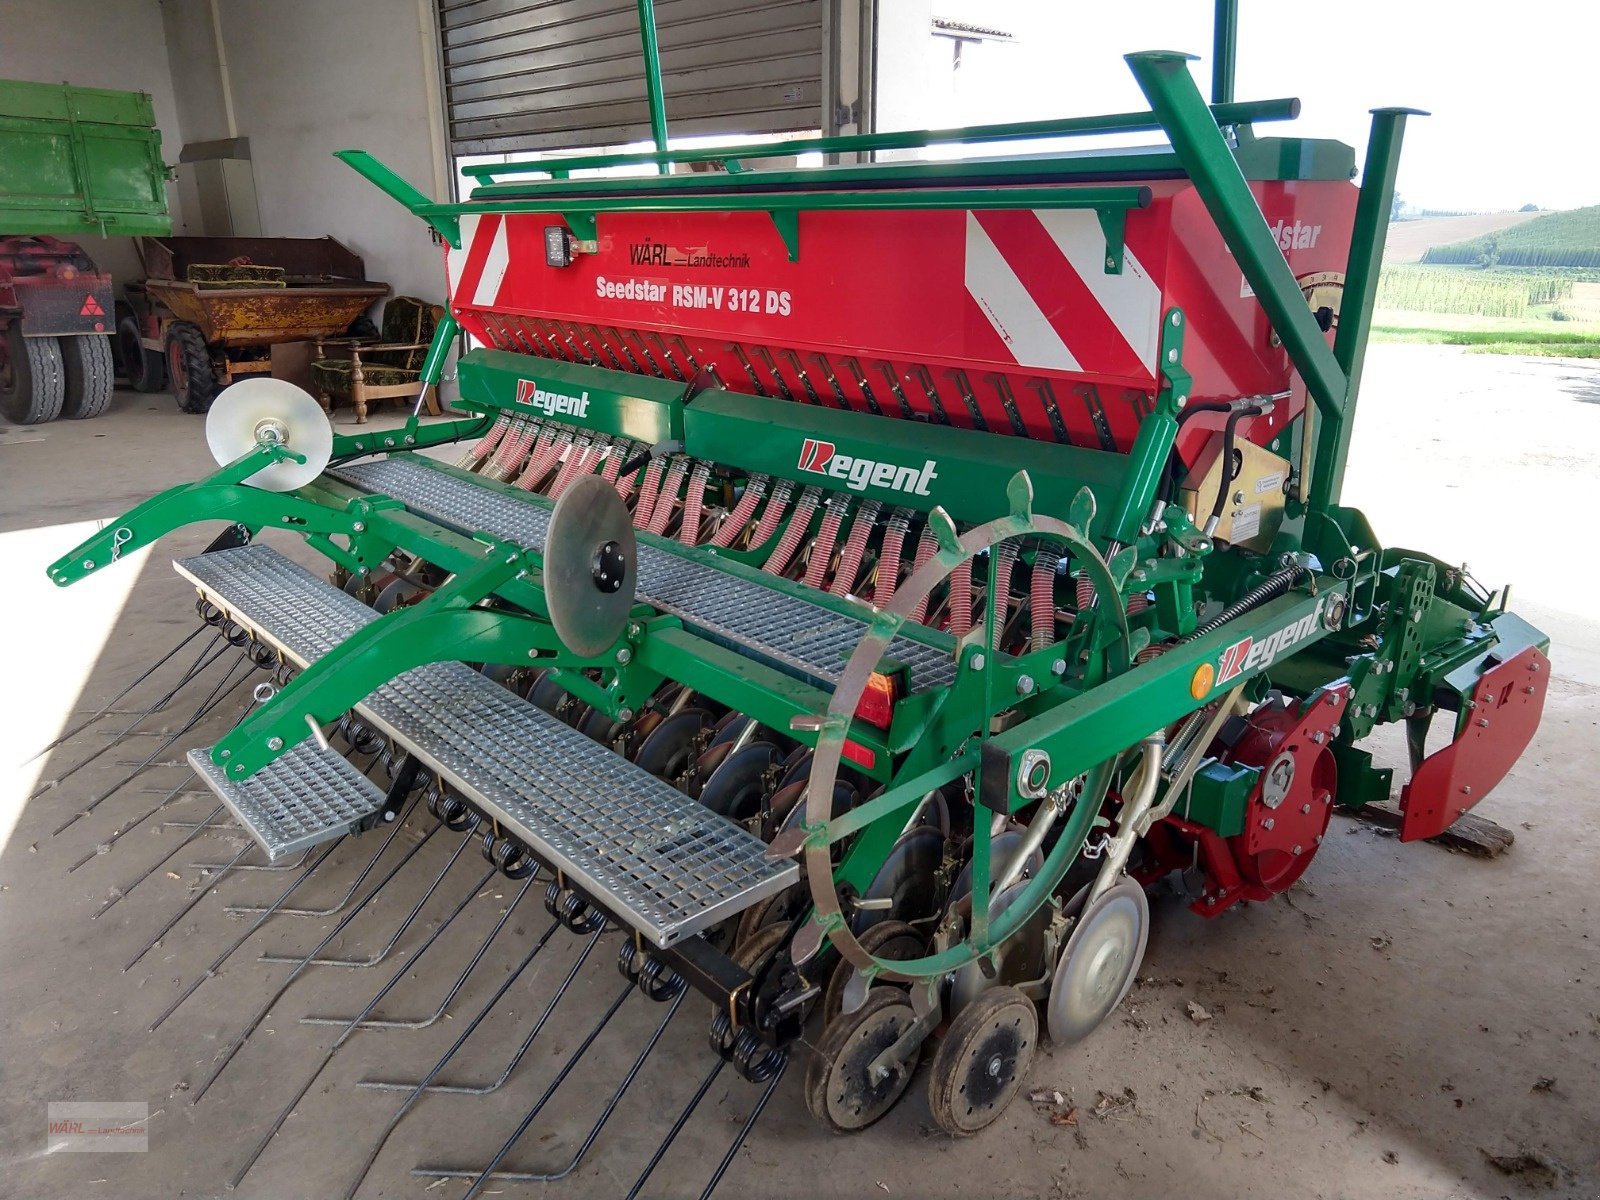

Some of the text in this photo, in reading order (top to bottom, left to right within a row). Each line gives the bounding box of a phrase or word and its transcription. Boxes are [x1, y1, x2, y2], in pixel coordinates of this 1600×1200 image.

[630, 237, 750, 268] WÄRL Landtechnik
[596, 276, 792, 316] Seedstar RSM-V 312 DS
[516, 378, 590, 418] Regent
[797, 438, 939, 496] Regent
[1215, 597, 1325, 687] Regent
